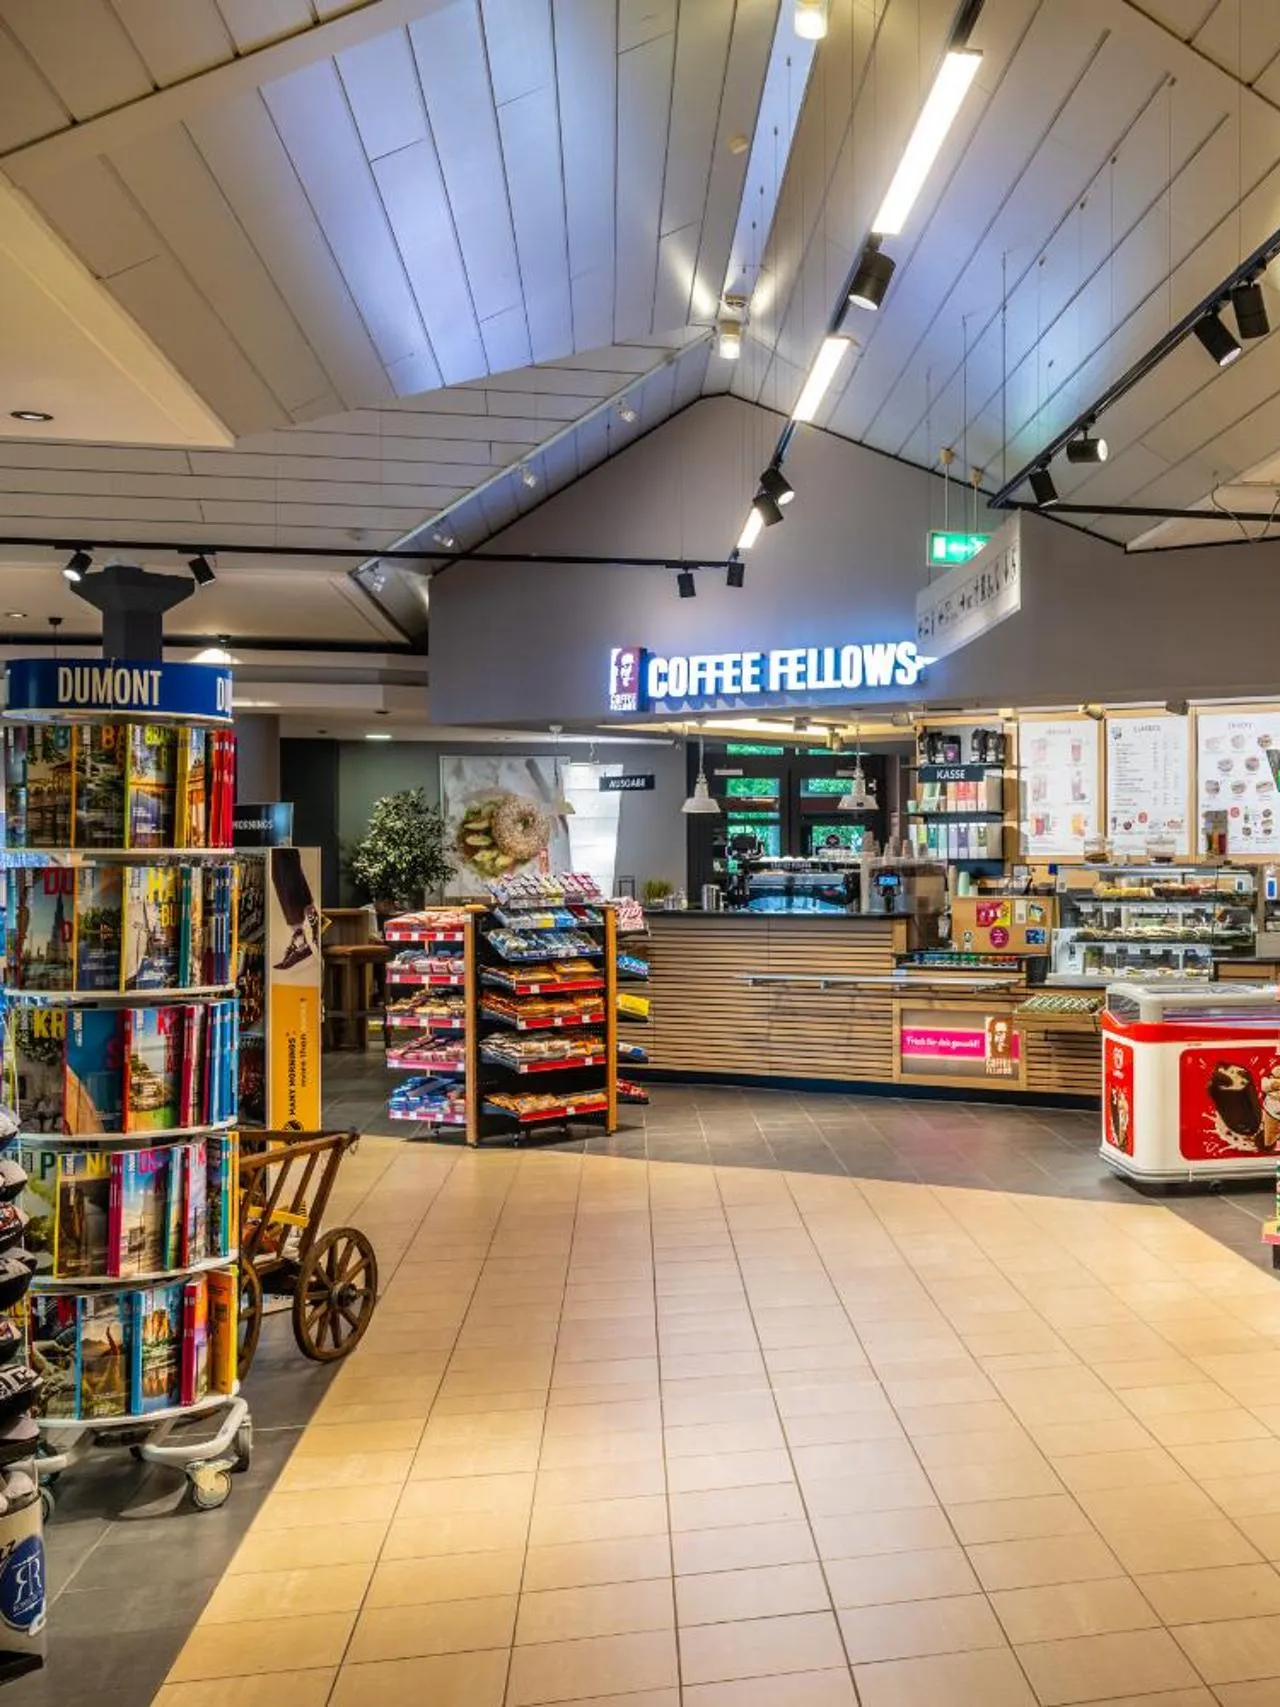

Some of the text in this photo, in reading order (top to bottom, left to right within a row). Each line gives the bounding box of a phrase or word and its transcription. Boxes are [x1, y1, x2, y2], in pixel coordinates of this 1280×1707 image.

[57, 667, 162, 707] DUMONT
[649, 641, 918, 698] COFFEE FELLOWS
[937, 770, 965, 779] KASSE
